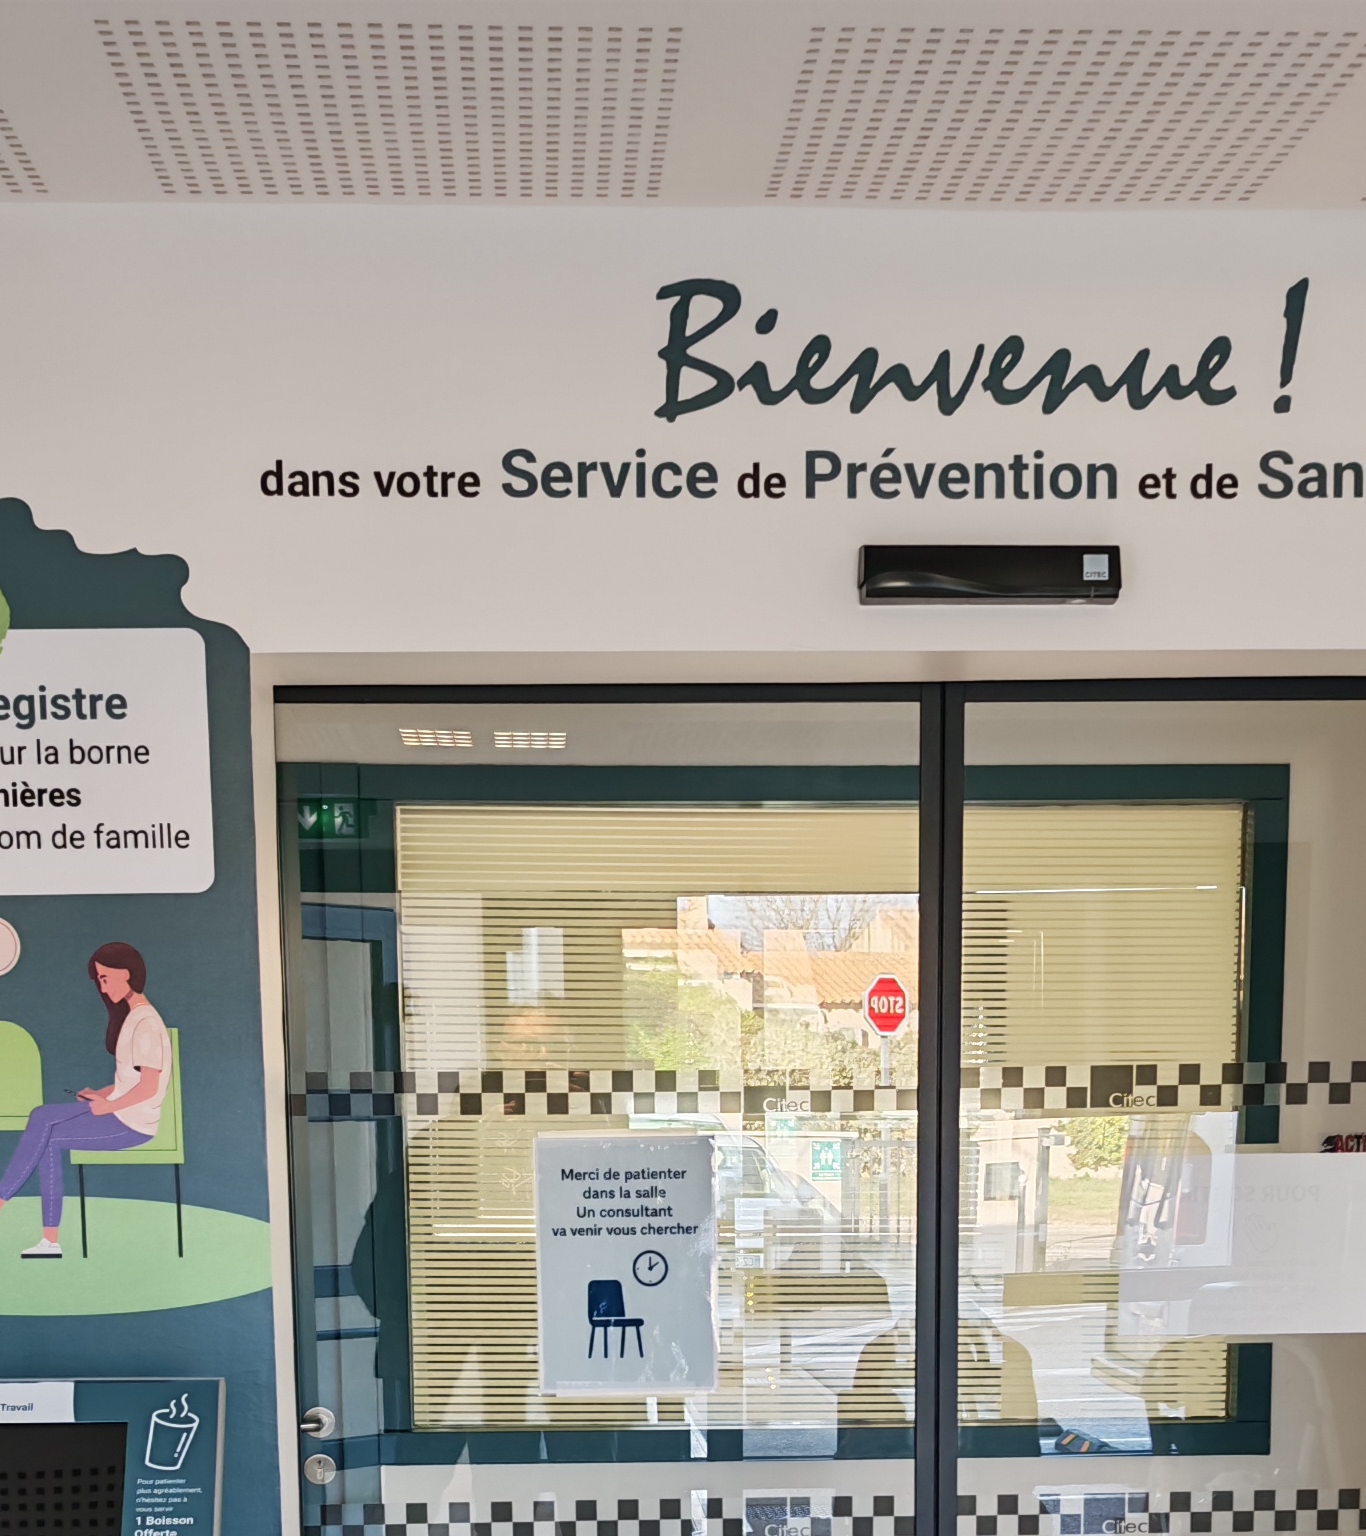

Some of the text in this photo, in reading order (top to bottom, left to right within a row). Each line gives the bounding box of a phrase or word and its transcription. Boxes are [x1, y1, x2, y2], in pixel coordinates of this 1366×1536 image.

[654, 277, 1309, 423] Bienvenue !
[261, 460, 359, 497] dans
[374, 465, 480, 498] votre
[502, 448, 718, 498] Service
[738, 462, 786, 499] de
[806, 448, 1117, 499] Prévention
[1139, 468, 1177, 499] et
[1190, 463, 1238, 499] de
[1084, 571, 1107, 579] CITEC
[37, 739, 59, 764] la
[69, 738, 149, 764] borne
[52, 823, 85, 849] de
[94, 823, 189, 849] famille
[763, 1097, 809, 1112] Citec
[1108, 1092, 1156, 1108] Citec
[561, 1168, 687, 1182] Merci de patienter
[583, 1186, 666, 1199] dans la salle
[577, 1205, 673, 1218] Un consultant
[552, 1223, 698, 1236] va venir vous chercher
[0, 1403, 33, 1411] Travail
[135, 1515, 194, 1526] 1 Boisson
[1101, 1519, 1148, 1534] Citec
